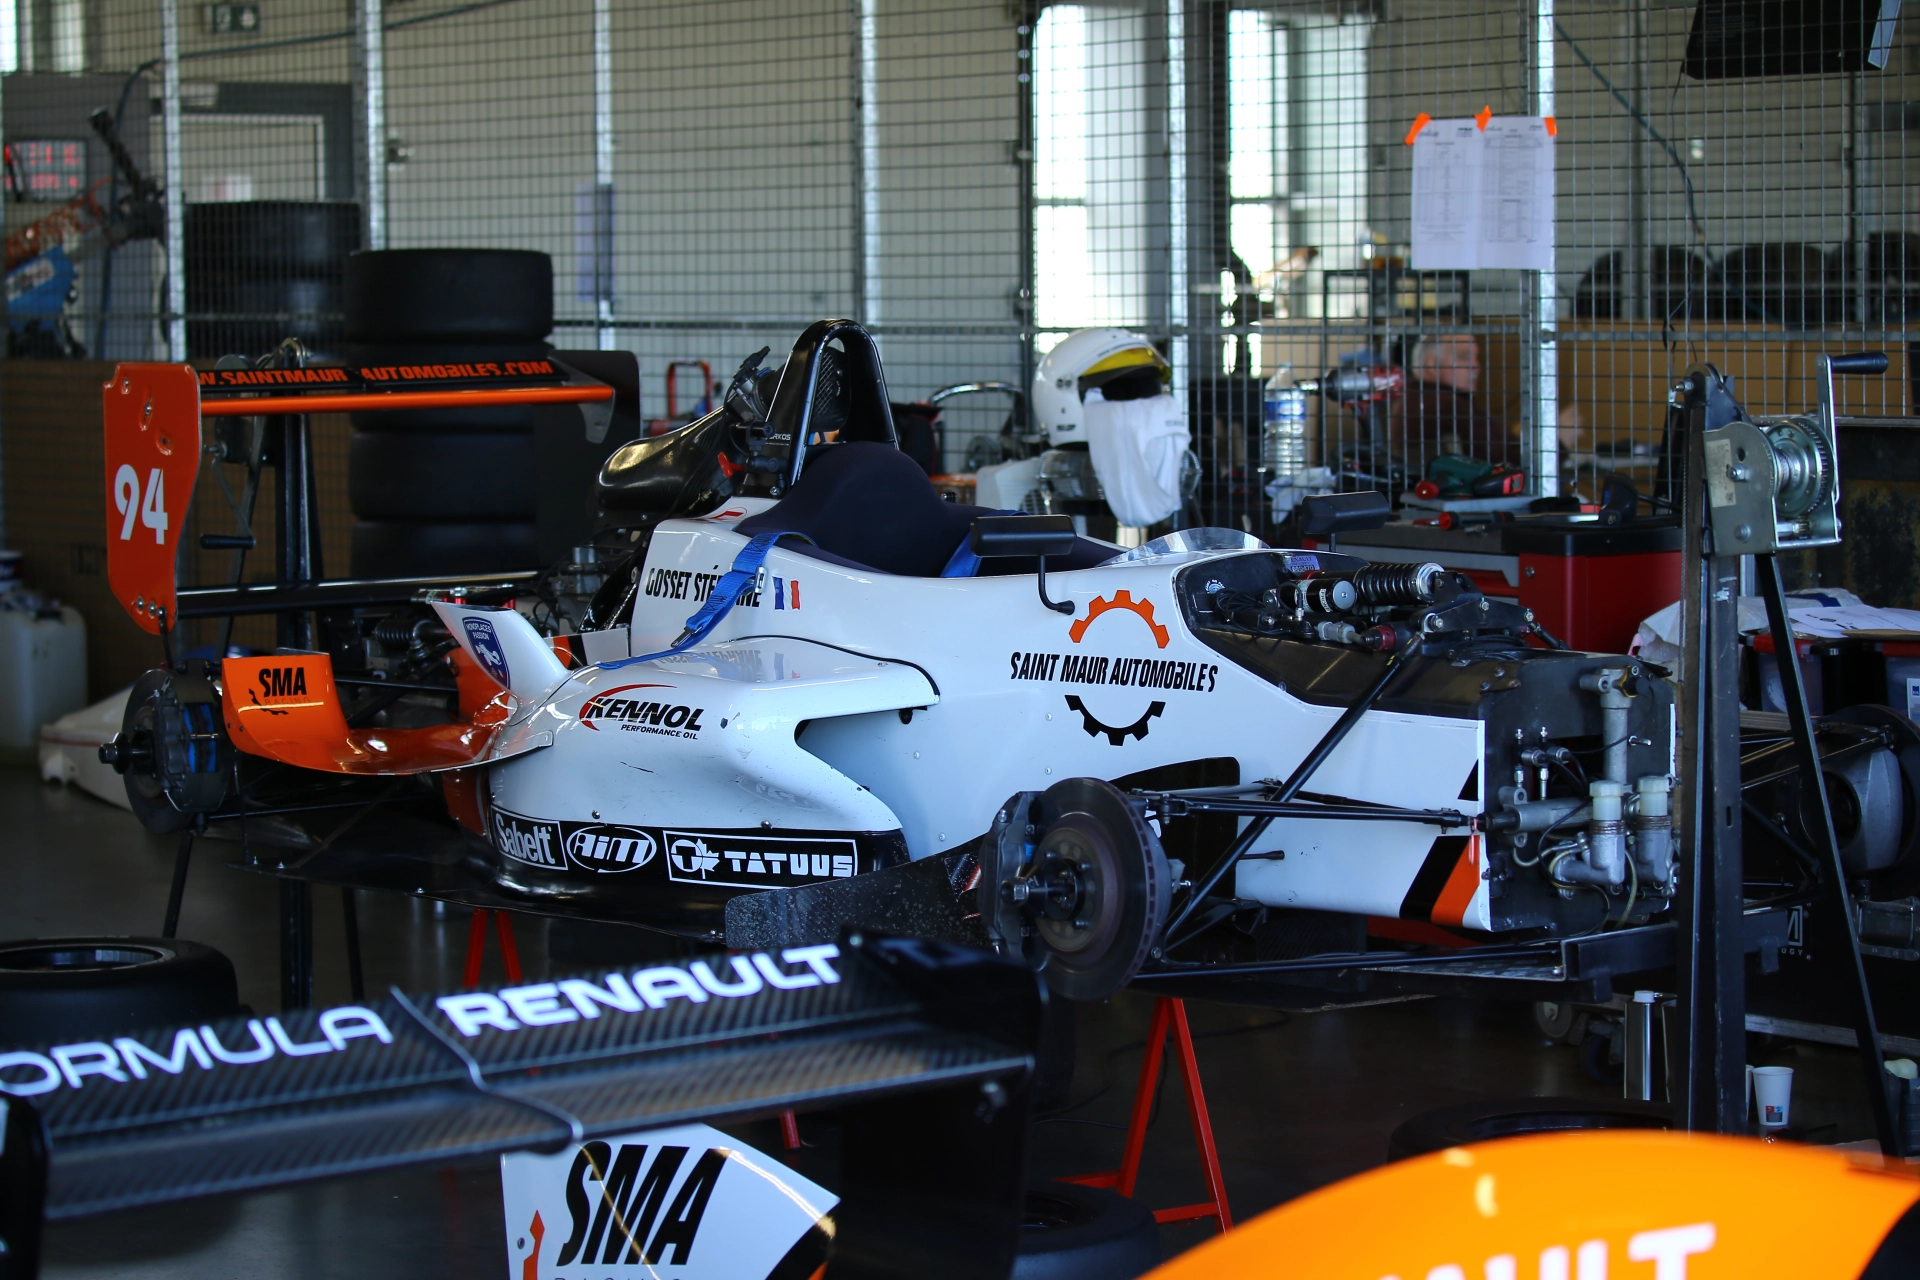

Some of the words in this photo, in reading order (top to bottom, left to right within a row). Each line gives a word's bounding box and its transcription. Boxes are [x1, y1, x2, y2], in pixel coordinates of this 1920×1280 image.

[114, 463, 168, 545] 94
[645, 567, 693, 600] GOSSET
[258, 667, 307, 697] SMA
[1010, 651, 1060, 682] SAINT
[1060, 654, 1110, 685] MAUR
[1108, 657, 1219, 693] AUTOMOBILES
[585, 697, 704, 731] KENNOL
[620, 724, 682, 738] PERFORMANCE
[682, 731, 699, 740] OIL
[496, 813, 556, 865] Sabelt
[724, 850, 853, 878] TATUUS
[436, 943, 841, 1037] RENAULT
[556, 1140, 732, 1267] SMA
